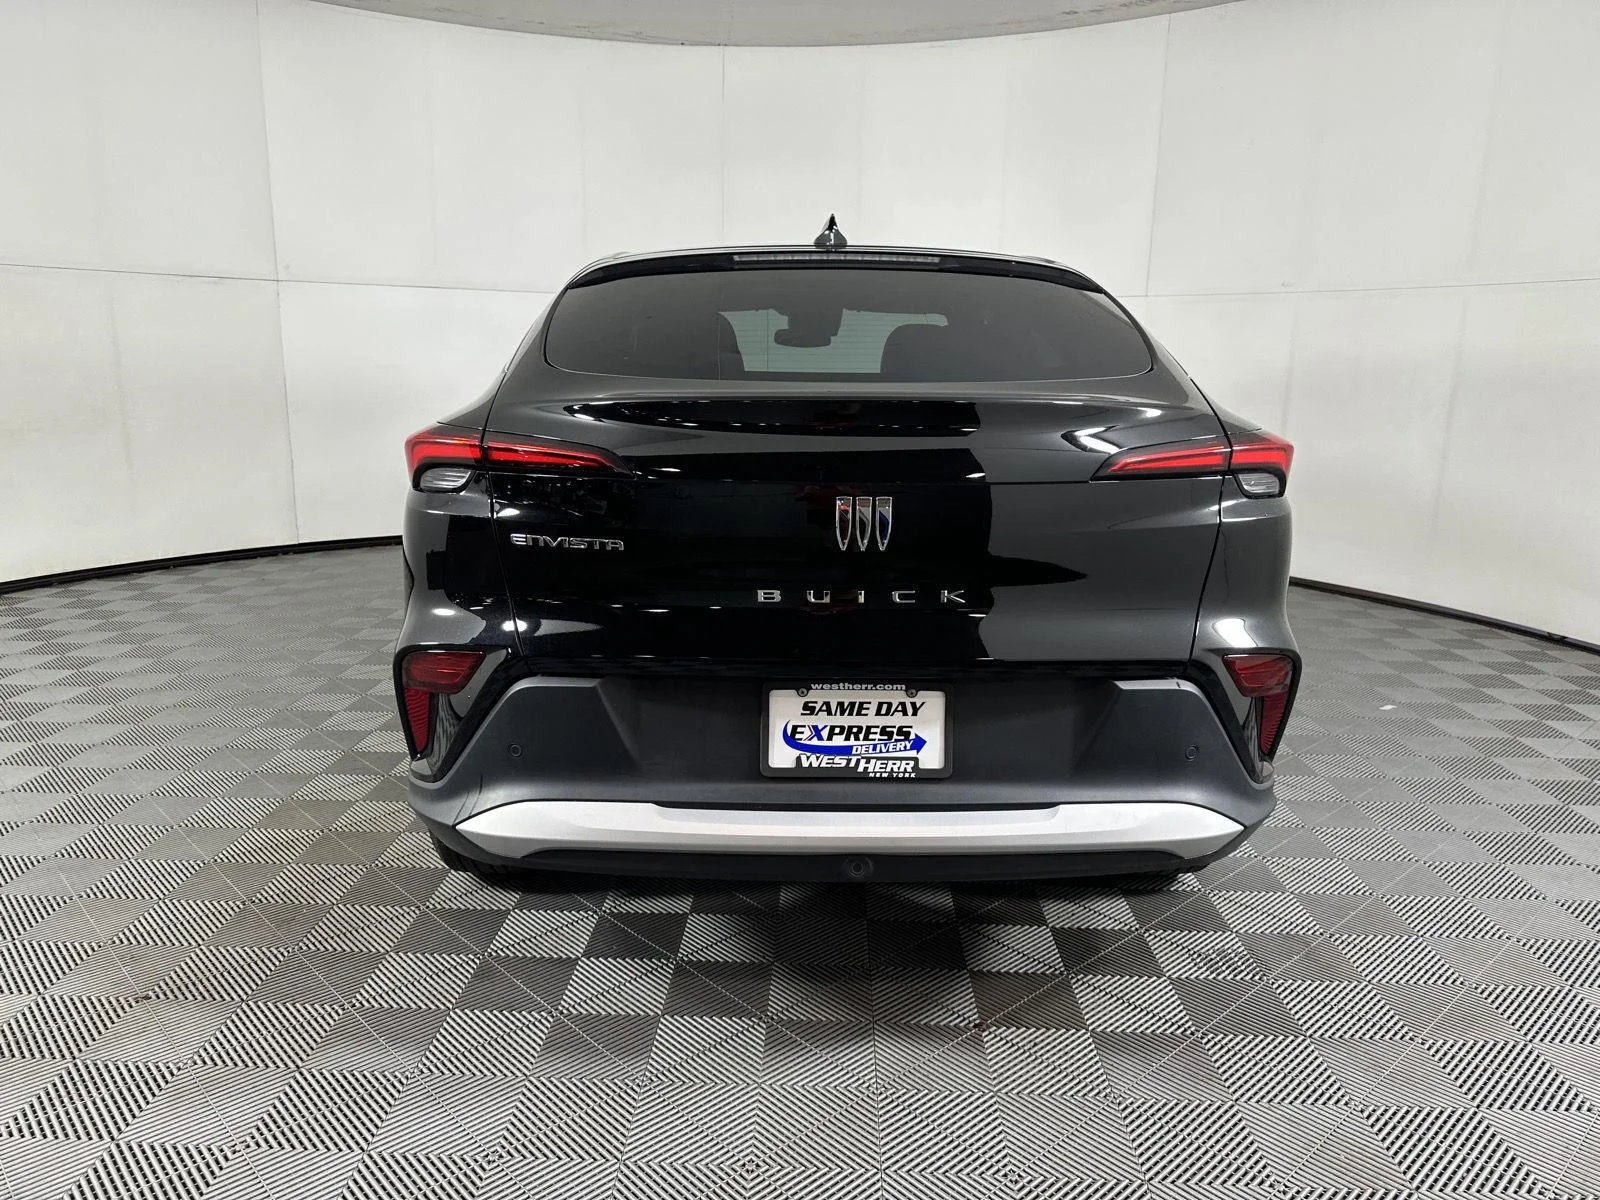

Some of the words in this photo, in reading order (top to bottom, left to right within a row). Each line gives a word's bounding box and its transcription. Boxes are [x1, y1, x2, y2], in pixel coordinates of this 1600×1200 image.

[510, 533, 625, 551] ENVISTA
[757, 590, 966, 603] BUICK
[811, 682, 906, 691] westherr.com
[800, 700, 871, 717] SAME
[875, 701, 926, 717] DAY
[789, 724, 913, 742] EXPRESS
[851, 741, 914, 755] DELIVERY
